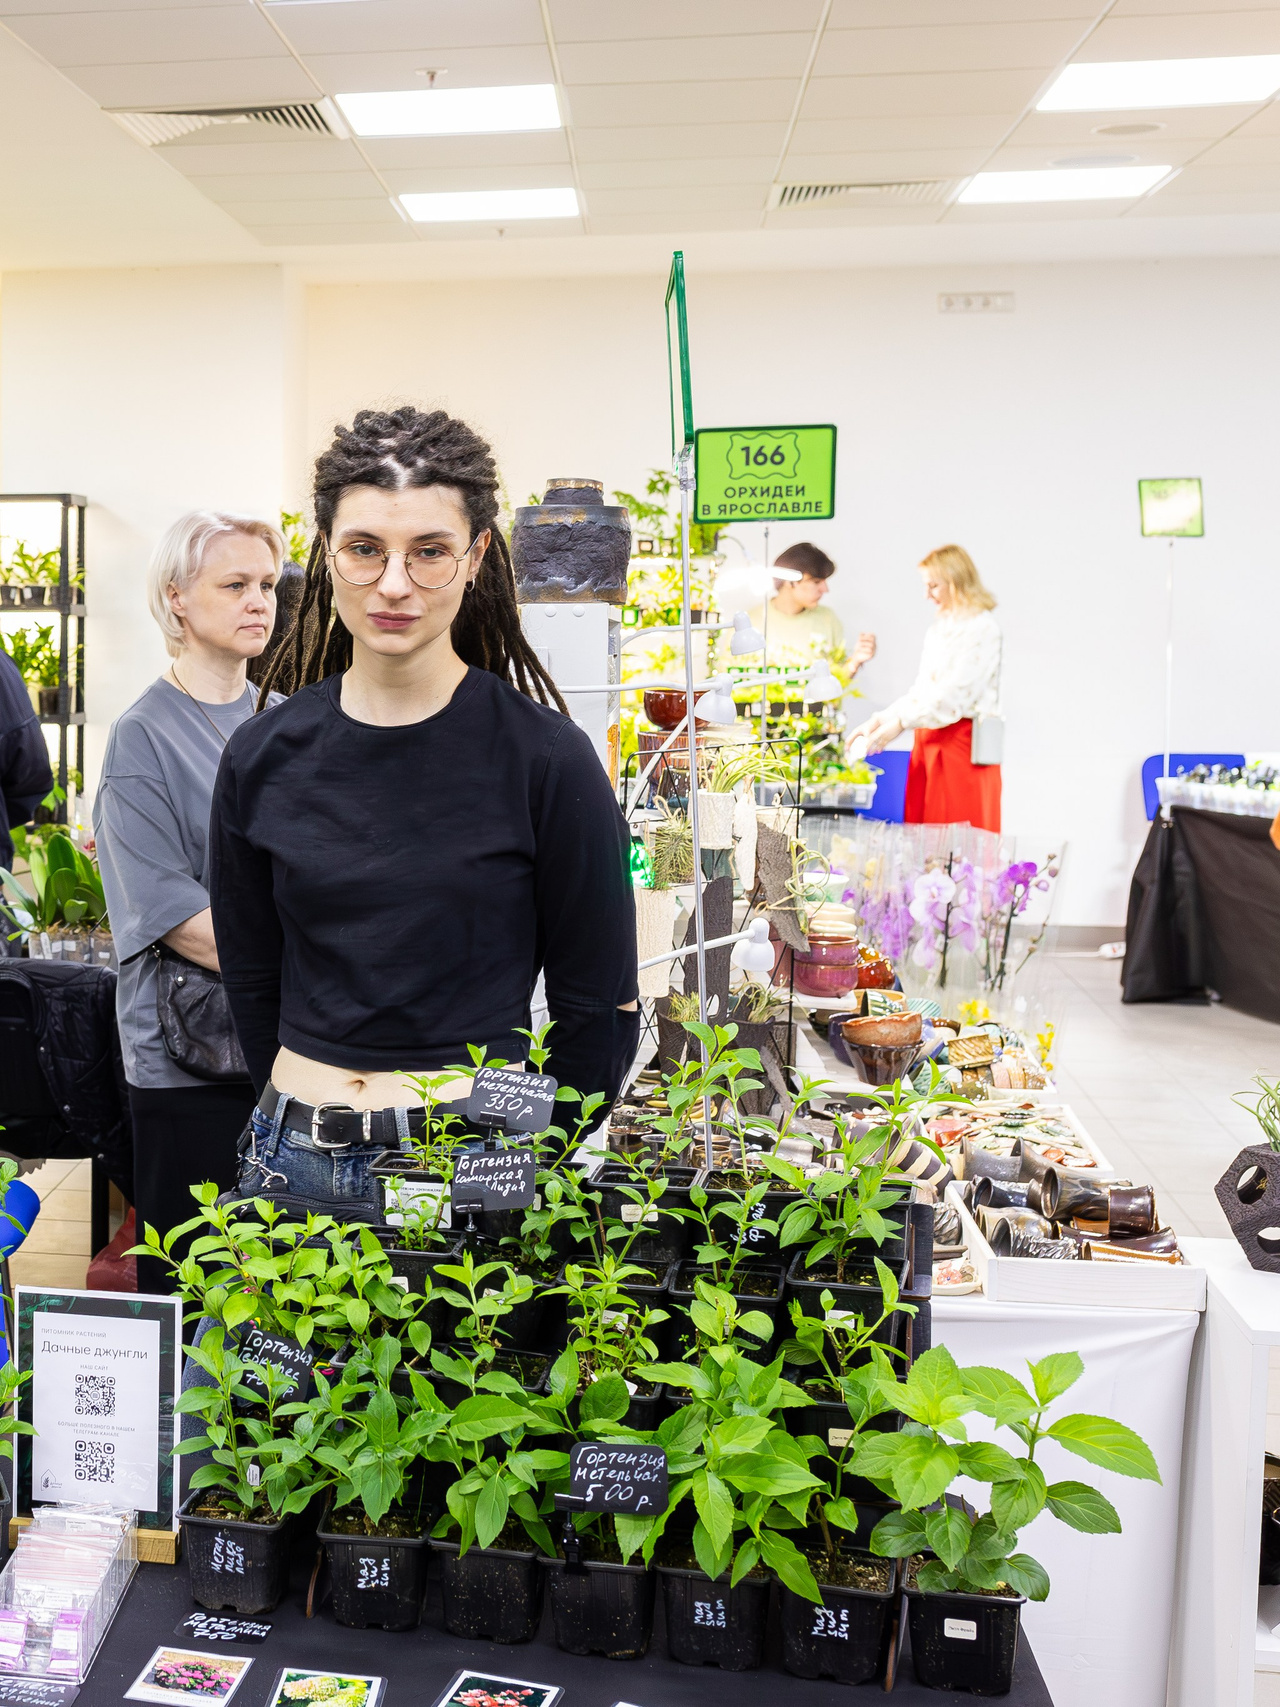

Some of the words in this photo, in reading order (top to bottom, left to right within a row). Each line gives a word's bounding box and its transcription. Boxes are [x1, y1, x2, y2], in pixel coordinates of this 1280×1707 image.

[740, 445, 785, 466] 166
[723, 485, 806, 499] ОРХИДЕИ
[701, 504, 711, 516] В
[718, 501, 823, 516] ЯРОСЛАВЛЕ
[485, 1093, 523, 1111] 350
[41, 1328, 75, 1336] ПИТОМНИК
[76, 1330, 107, 1339] РАСТЕНИЙ
[41, 1340, 91, 1355] Дачные
[93, 1347, 148, 1360] джунгли
[57, 1420, 78, 1428] БОЛЬШЕ
[79, 1422, 111, 1430] ПОЛЕЗНОГО
[585, 1483, 634, 1502] 500
